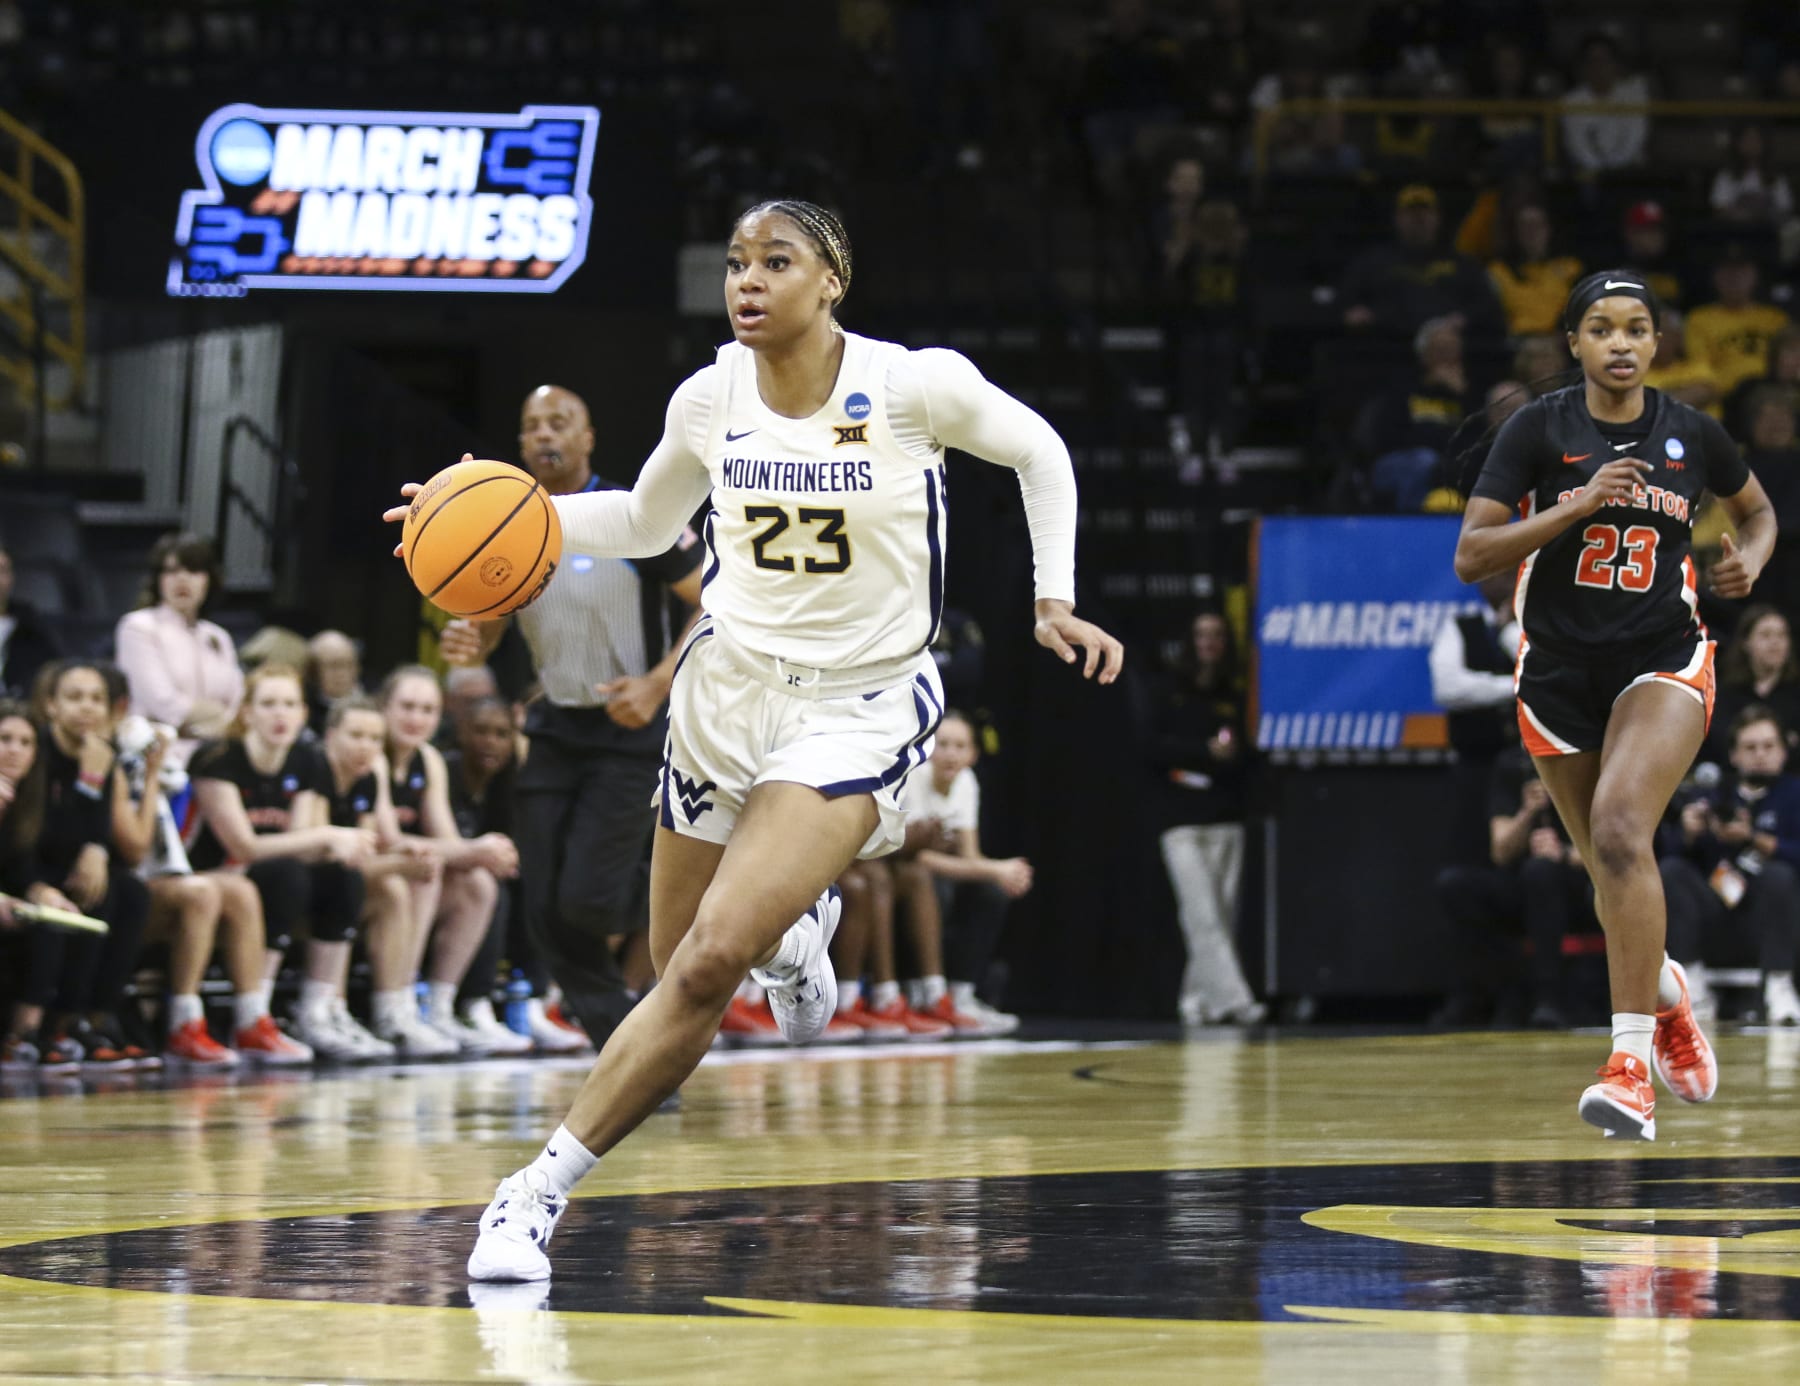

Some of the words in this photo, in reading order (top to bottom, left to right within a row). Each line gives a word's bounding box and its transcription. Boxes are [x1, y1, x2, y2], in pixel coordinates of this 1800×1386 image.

[269, 123, 484, 192] MARCH
[294, 190, 579, 262] MADNESS
[723, 458, 873, 492] MOUNTAINEERS
[744, 504, 852, 574] 23
[1574, 523, 1660, 592] 23
